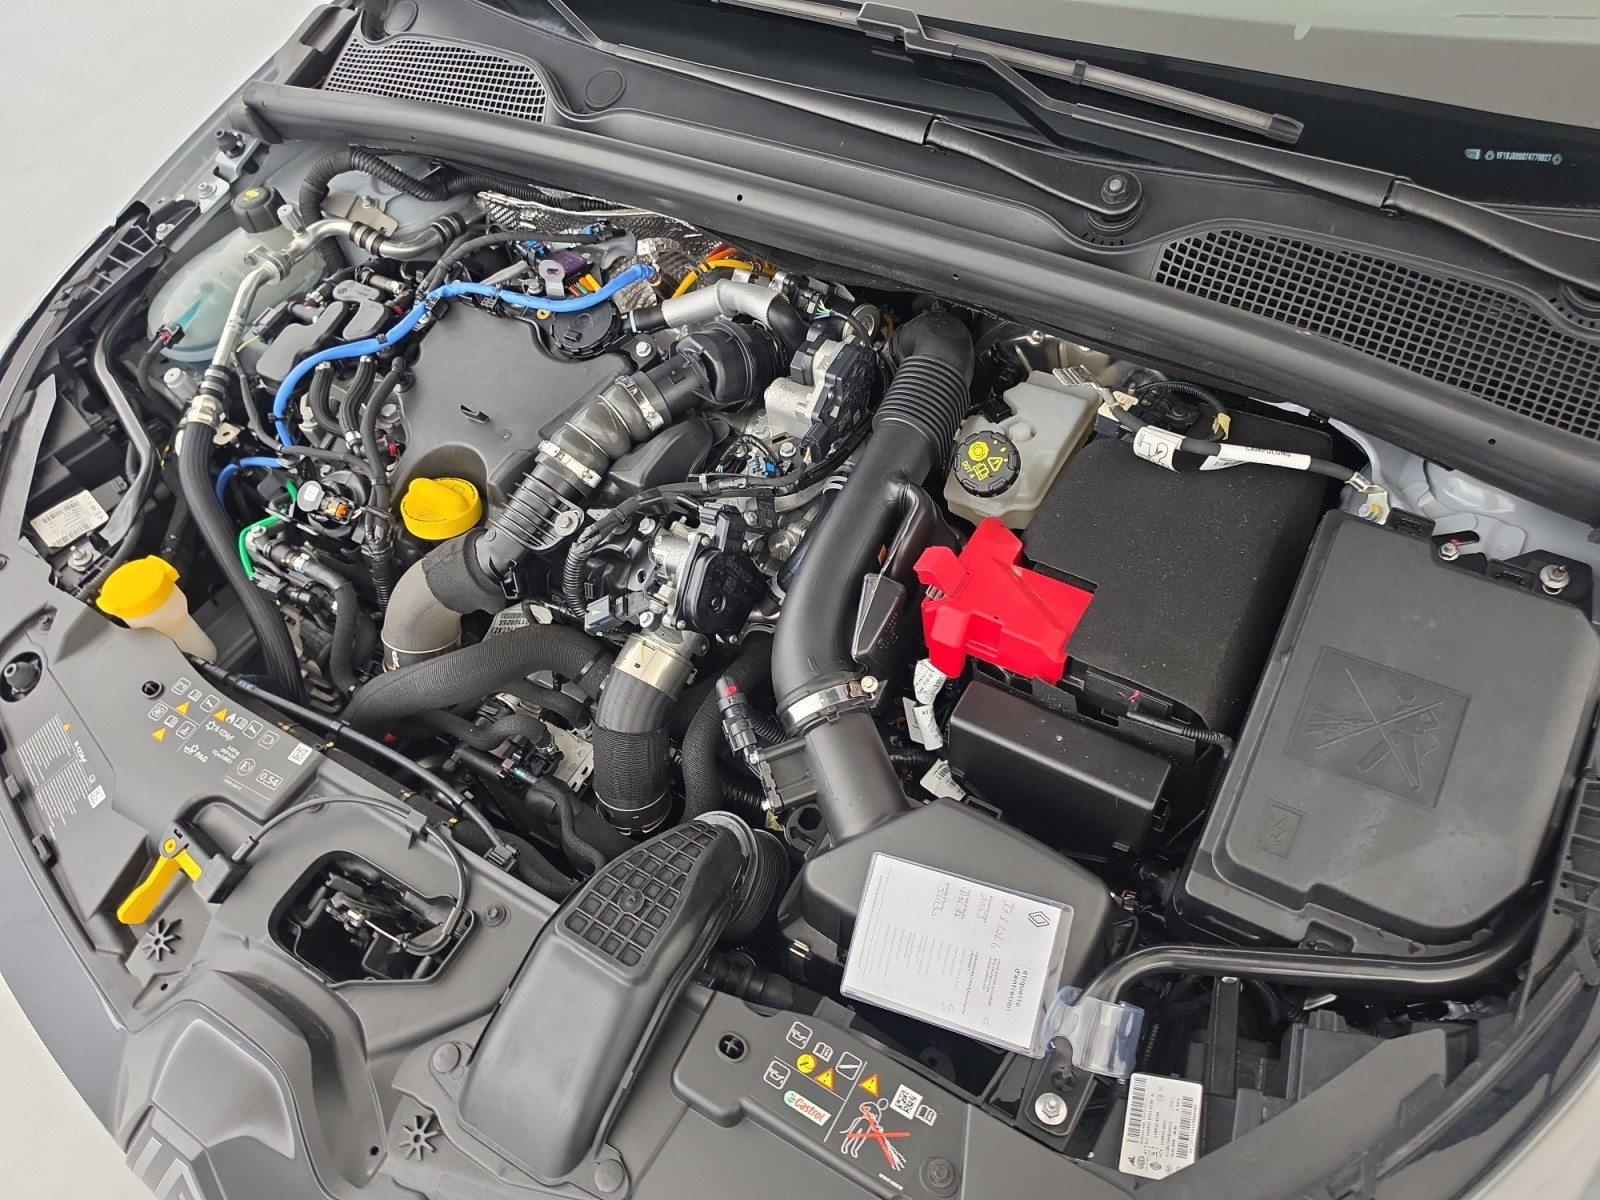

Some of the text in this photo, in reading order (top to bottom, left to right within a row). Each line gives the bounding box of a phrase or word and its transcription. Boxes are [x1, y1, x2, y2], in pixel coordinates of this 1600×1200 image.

[961, 460, 973, 473] DOT
[211, 725, 235, 742] R-1234yf
[193, 750, 208, 763] PAG
[258, 771, 279, 787] 0,54
[1005, 967, 1021, 1011] d'entretien
[1015, 970, 1029, 1007] étiquette
[793, 1097, 826, 1122] Castrol
